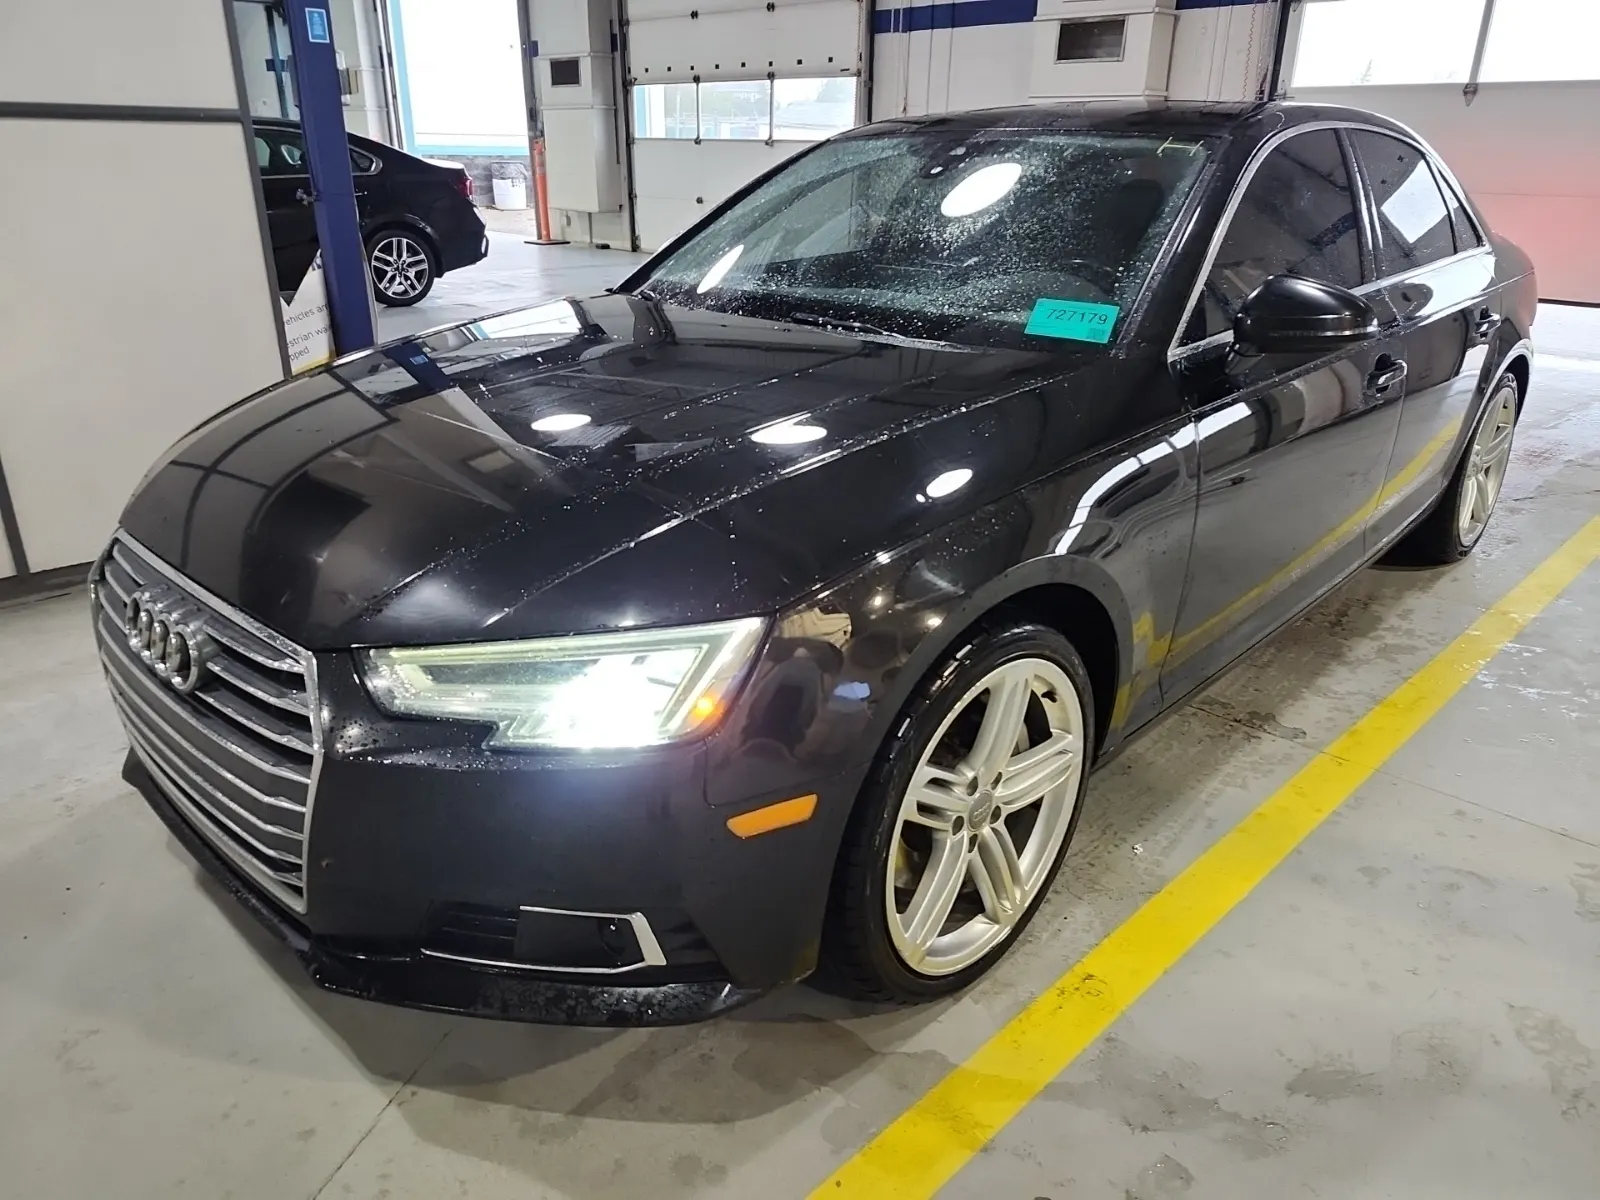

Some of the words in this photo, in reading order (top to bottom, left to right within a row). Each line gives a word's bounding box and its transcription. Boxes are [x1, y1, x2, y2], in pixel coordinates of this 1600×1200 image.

[285, 308, 315, 326] ehicles
[1046, 308, 1108, 325] 727179
[289, 346, 310, 362] pped
